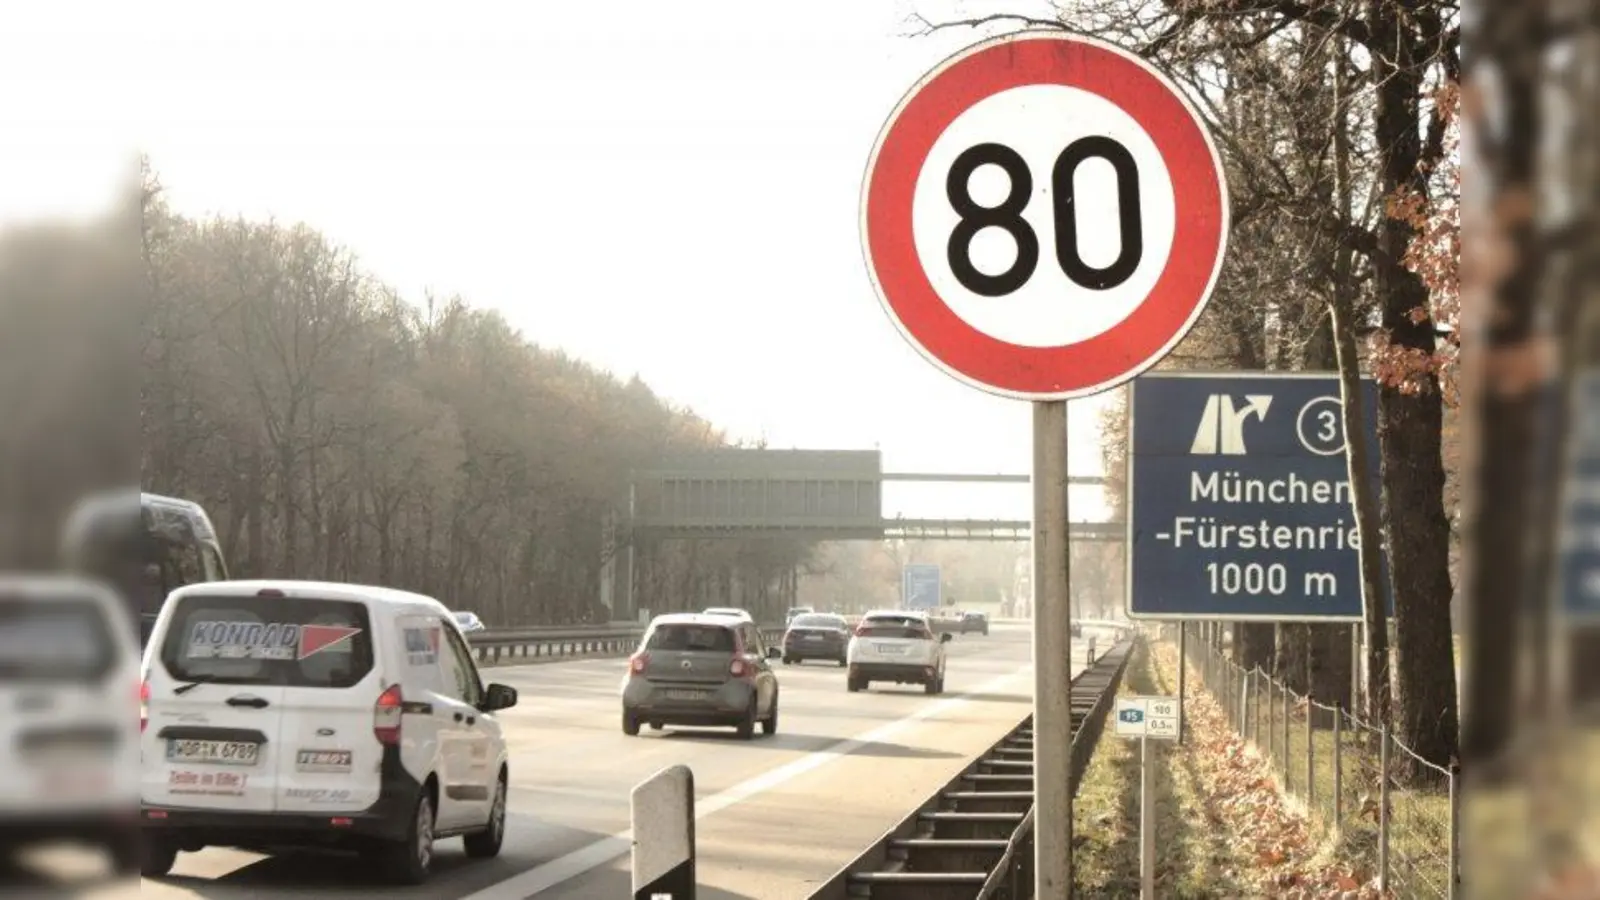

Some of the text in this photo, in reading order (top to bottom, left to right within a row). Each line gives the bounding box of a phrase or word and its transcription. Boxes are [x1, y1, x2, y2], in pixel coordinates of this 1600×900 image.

[946, 135, 1143, 297] 80
[1317, 410, 1336, 442] 3
[1191, 470, 1353, 504] München
[1207, 563, 1337, 596] 1000 m
[192, 620, 300, 647] KONRAD
